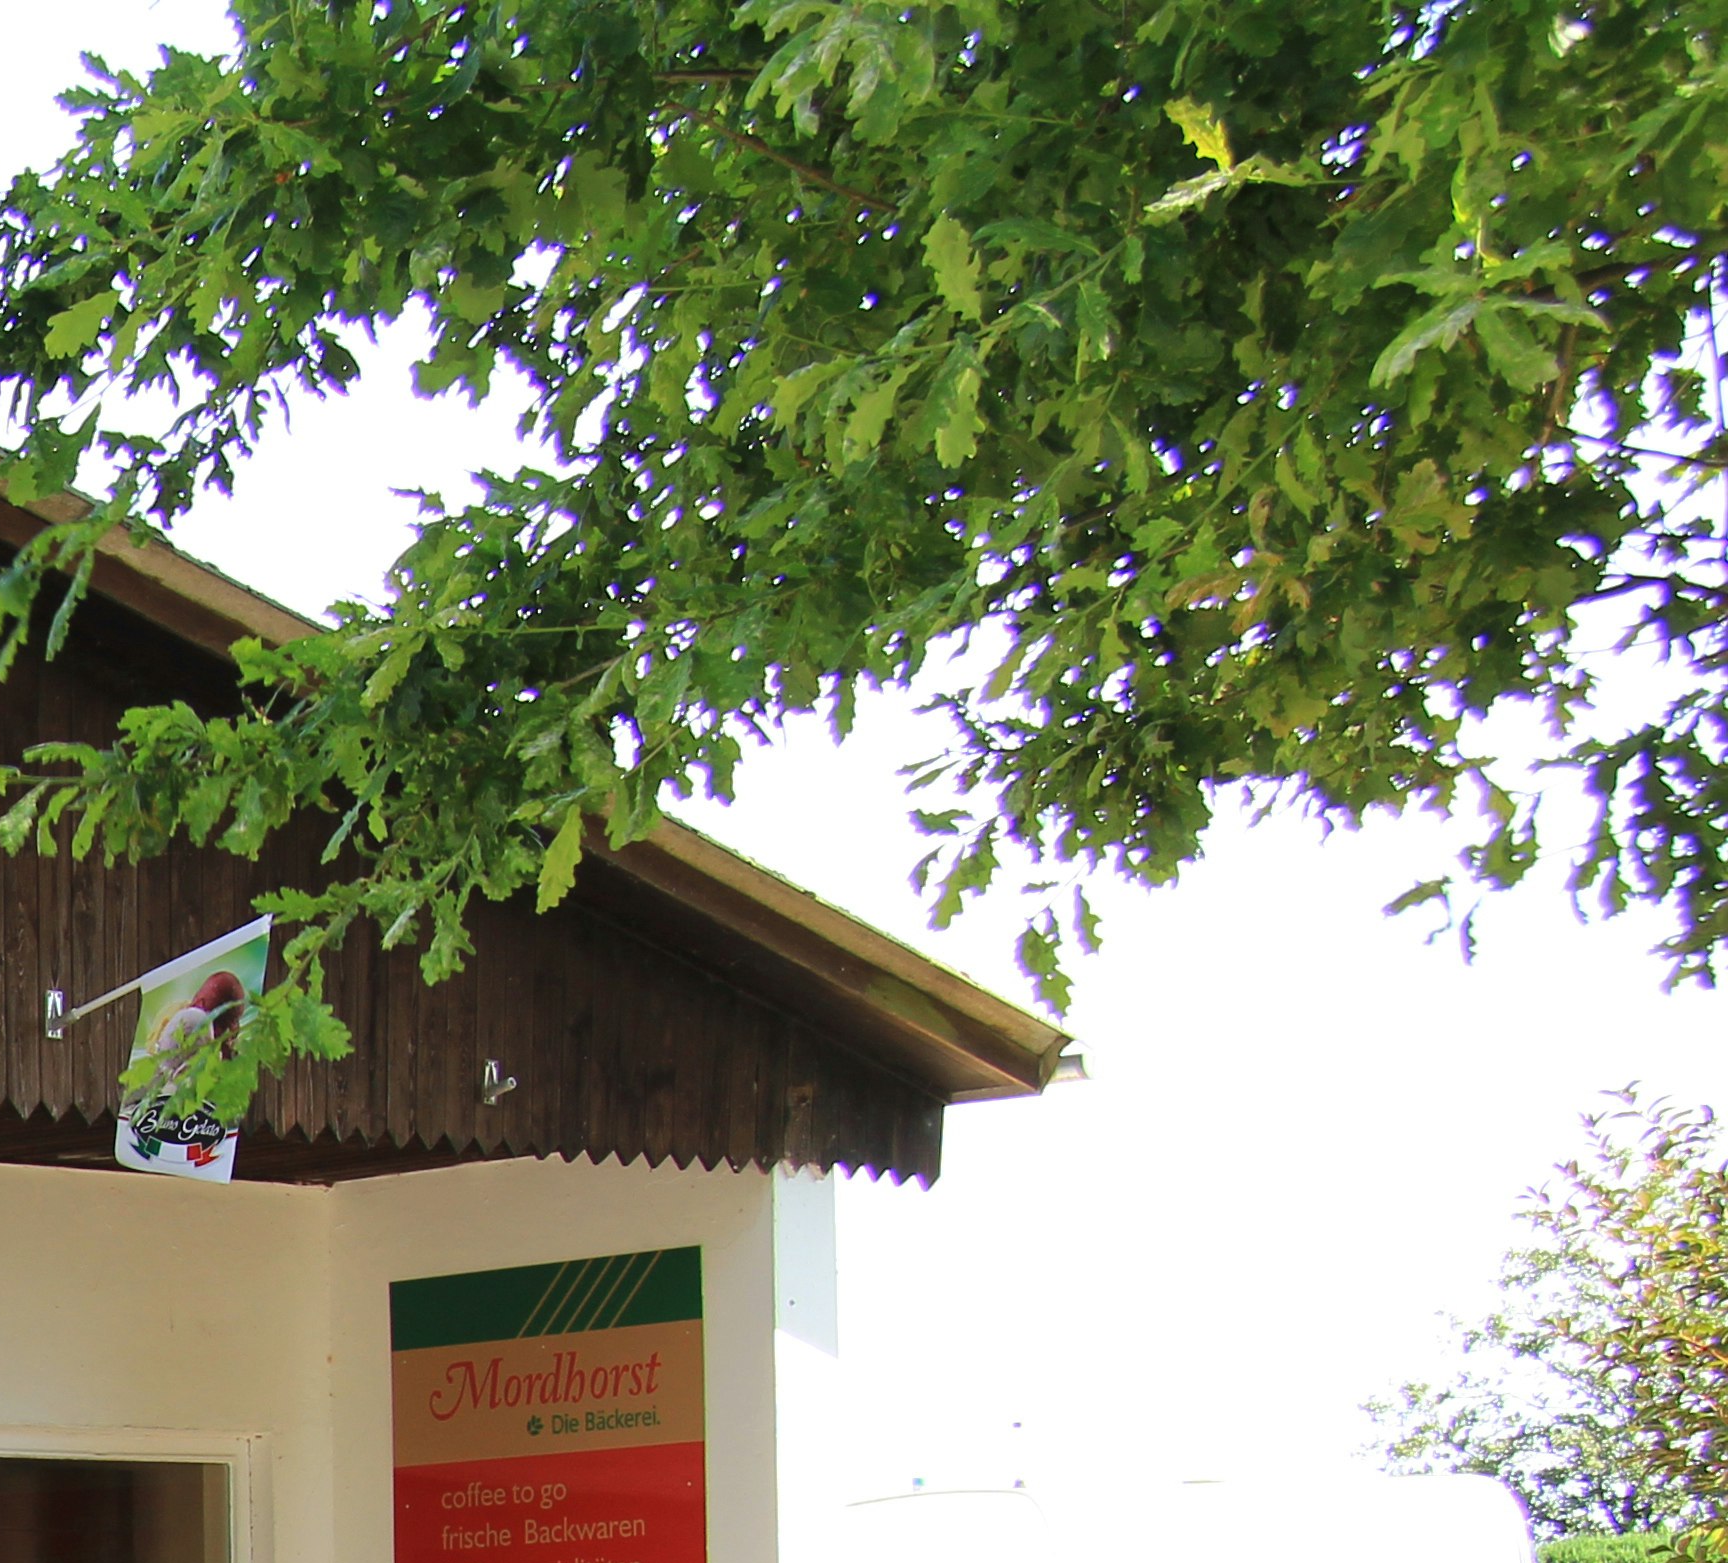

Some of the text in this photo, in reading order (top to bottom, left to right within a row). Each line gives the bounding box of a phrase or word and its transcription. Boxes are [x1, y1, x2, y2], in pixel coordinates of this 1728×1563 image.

[136, 1109, 220, 1141] Buno Gelato
[429, 1351, 662, 1421] Mordhorst
[552, 1405, 661, 1435] Die Bäckerei.
[441, 1482, 567, 1510] coffee to go
[441, 1516, 645, 1551] frische Backwaren
